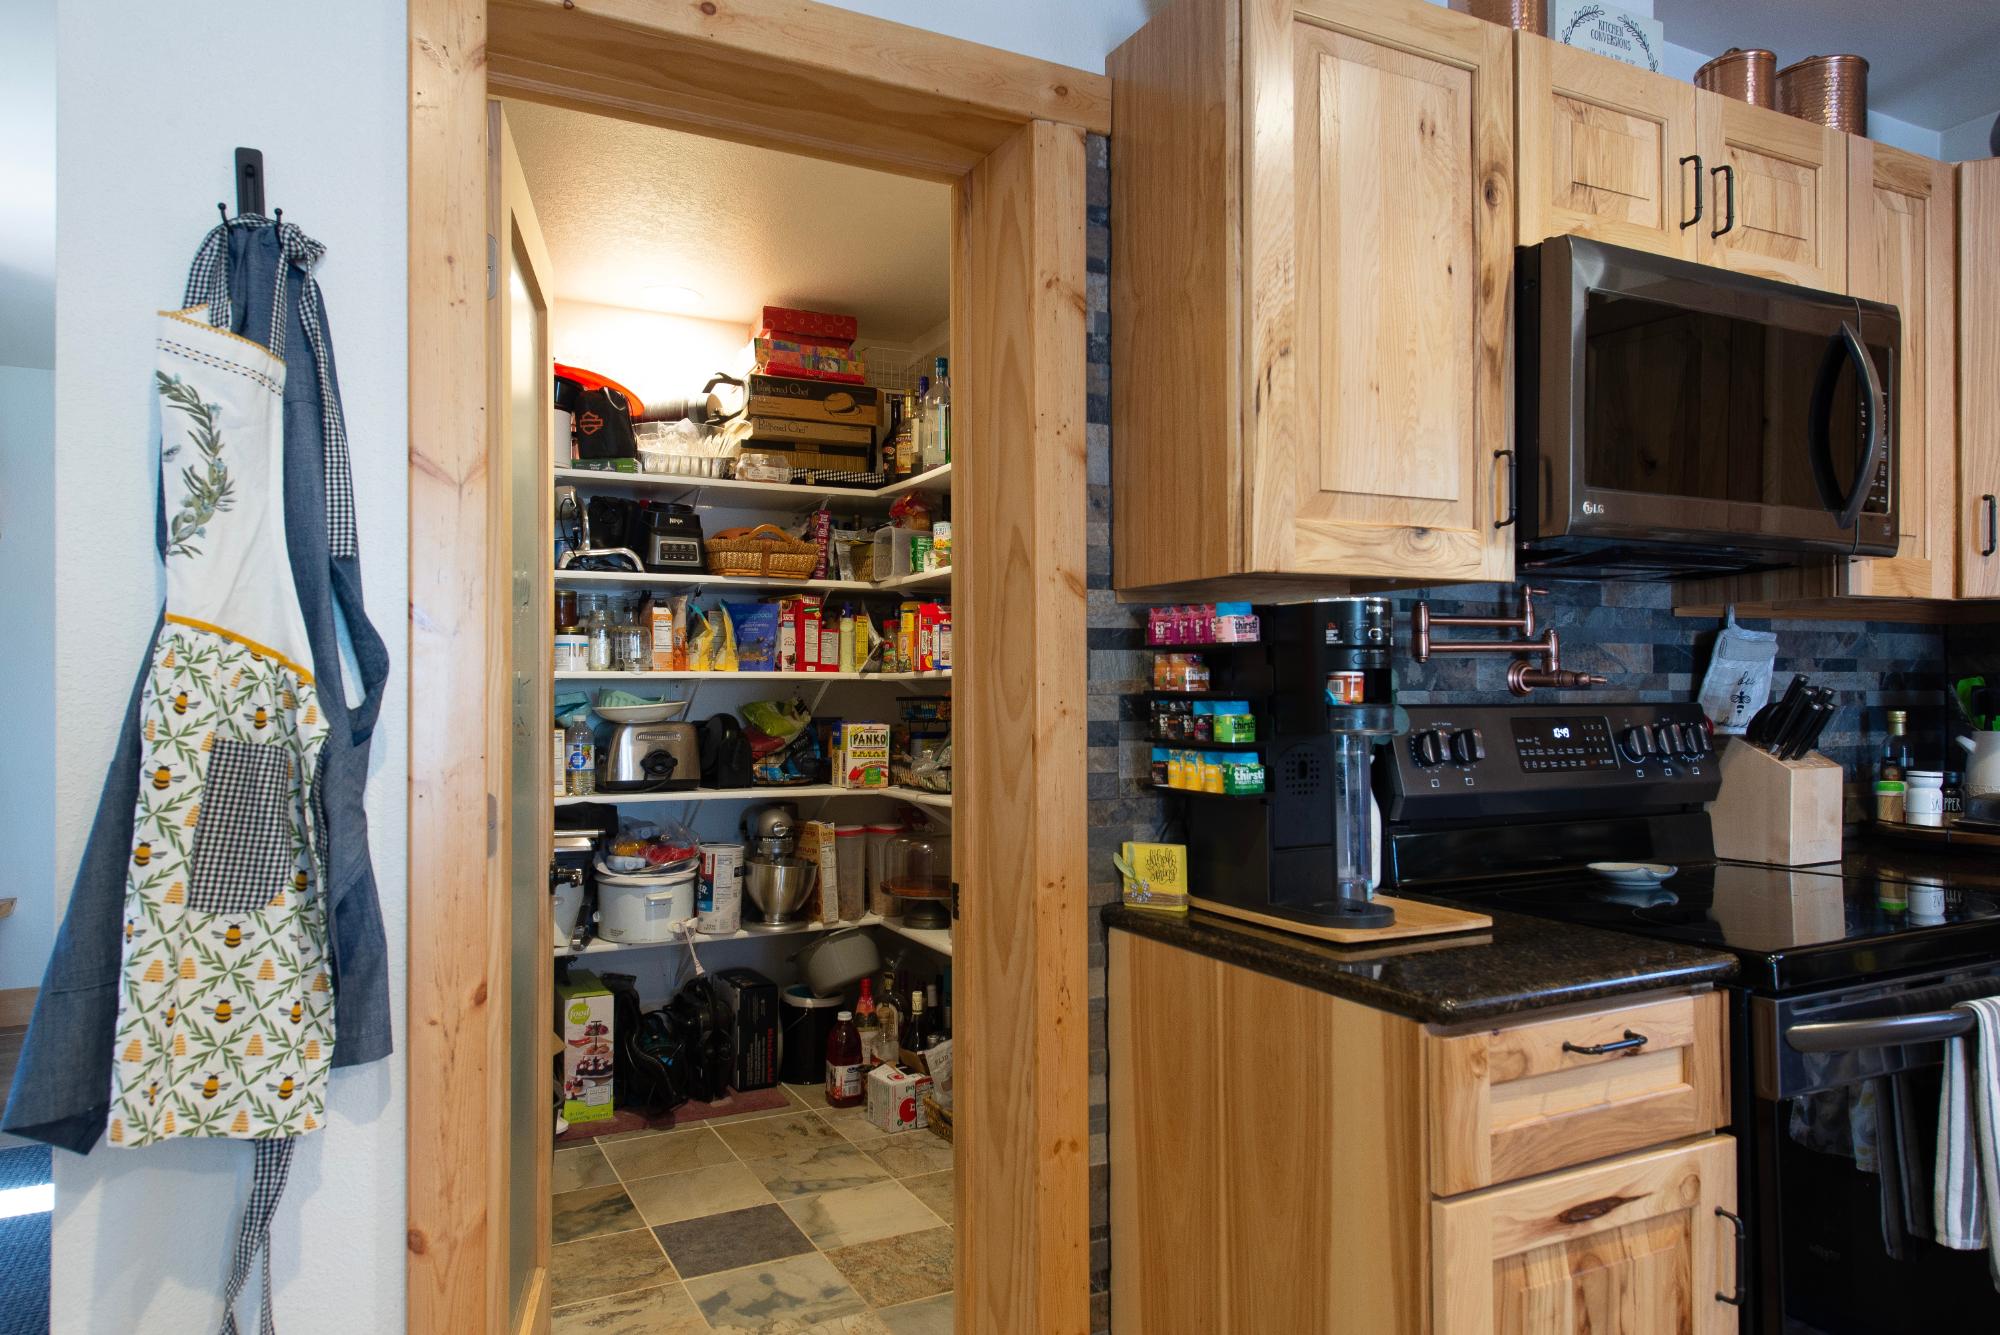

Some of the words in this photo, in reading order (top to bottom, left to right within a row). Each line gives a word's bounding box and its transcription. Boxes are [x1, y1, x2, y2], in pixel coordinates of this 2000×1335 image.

[1598, 19, 1624, 37] KITCHEN
[1590, 28, 1632, 51] CONVERSIONS
[853, 733, 887, 746] PANKO
[1234, 769, 1264, 781] thirsti
